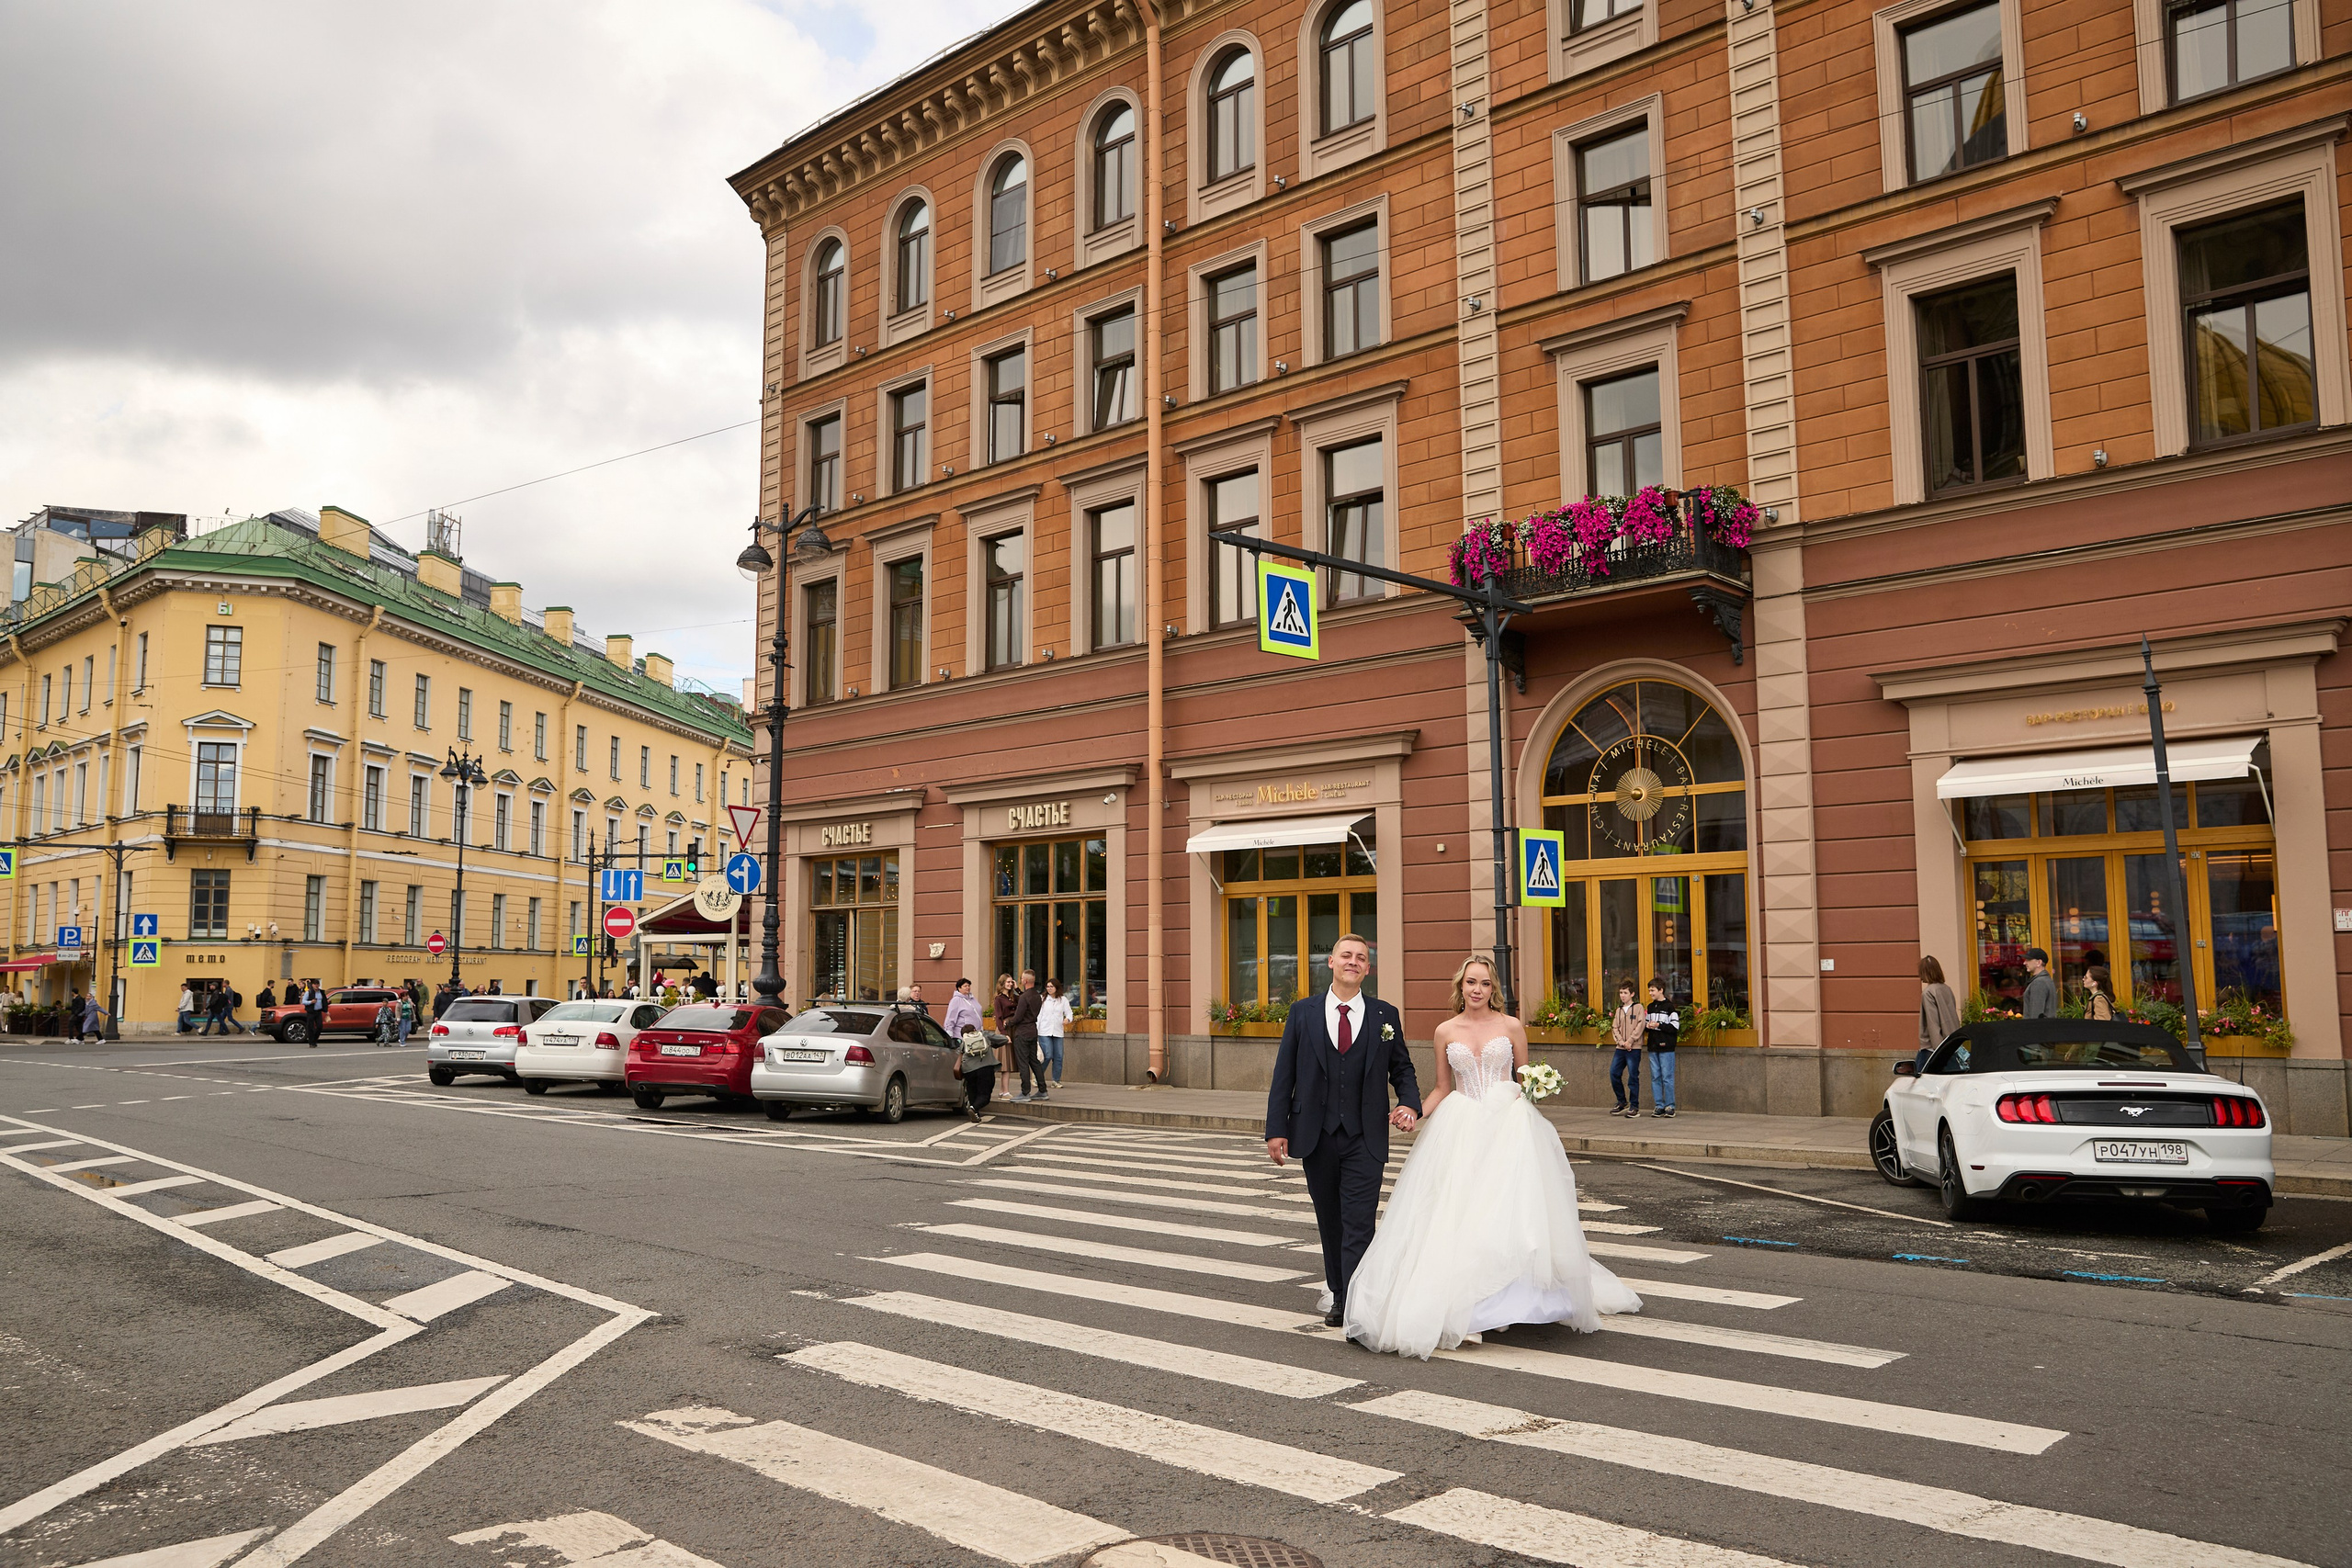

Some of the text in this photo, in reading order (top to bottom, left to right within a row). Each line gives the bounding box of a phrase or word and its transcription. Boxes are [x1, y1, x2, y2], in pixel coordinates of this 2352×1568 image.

[1611, 739, 1668, 759] MICHÈLE
[2063, 776, 2104, 786] Michèle
[1257, 782, 1318, 805] Michèle
[1008, 802, 1070, 829] СЧАСТЬЕ
[821, 822, 872, 846] СЧАСТЬЕ
[187, 954, 225, 964] memo
[2161, 1144, 2182, 1155] 198
